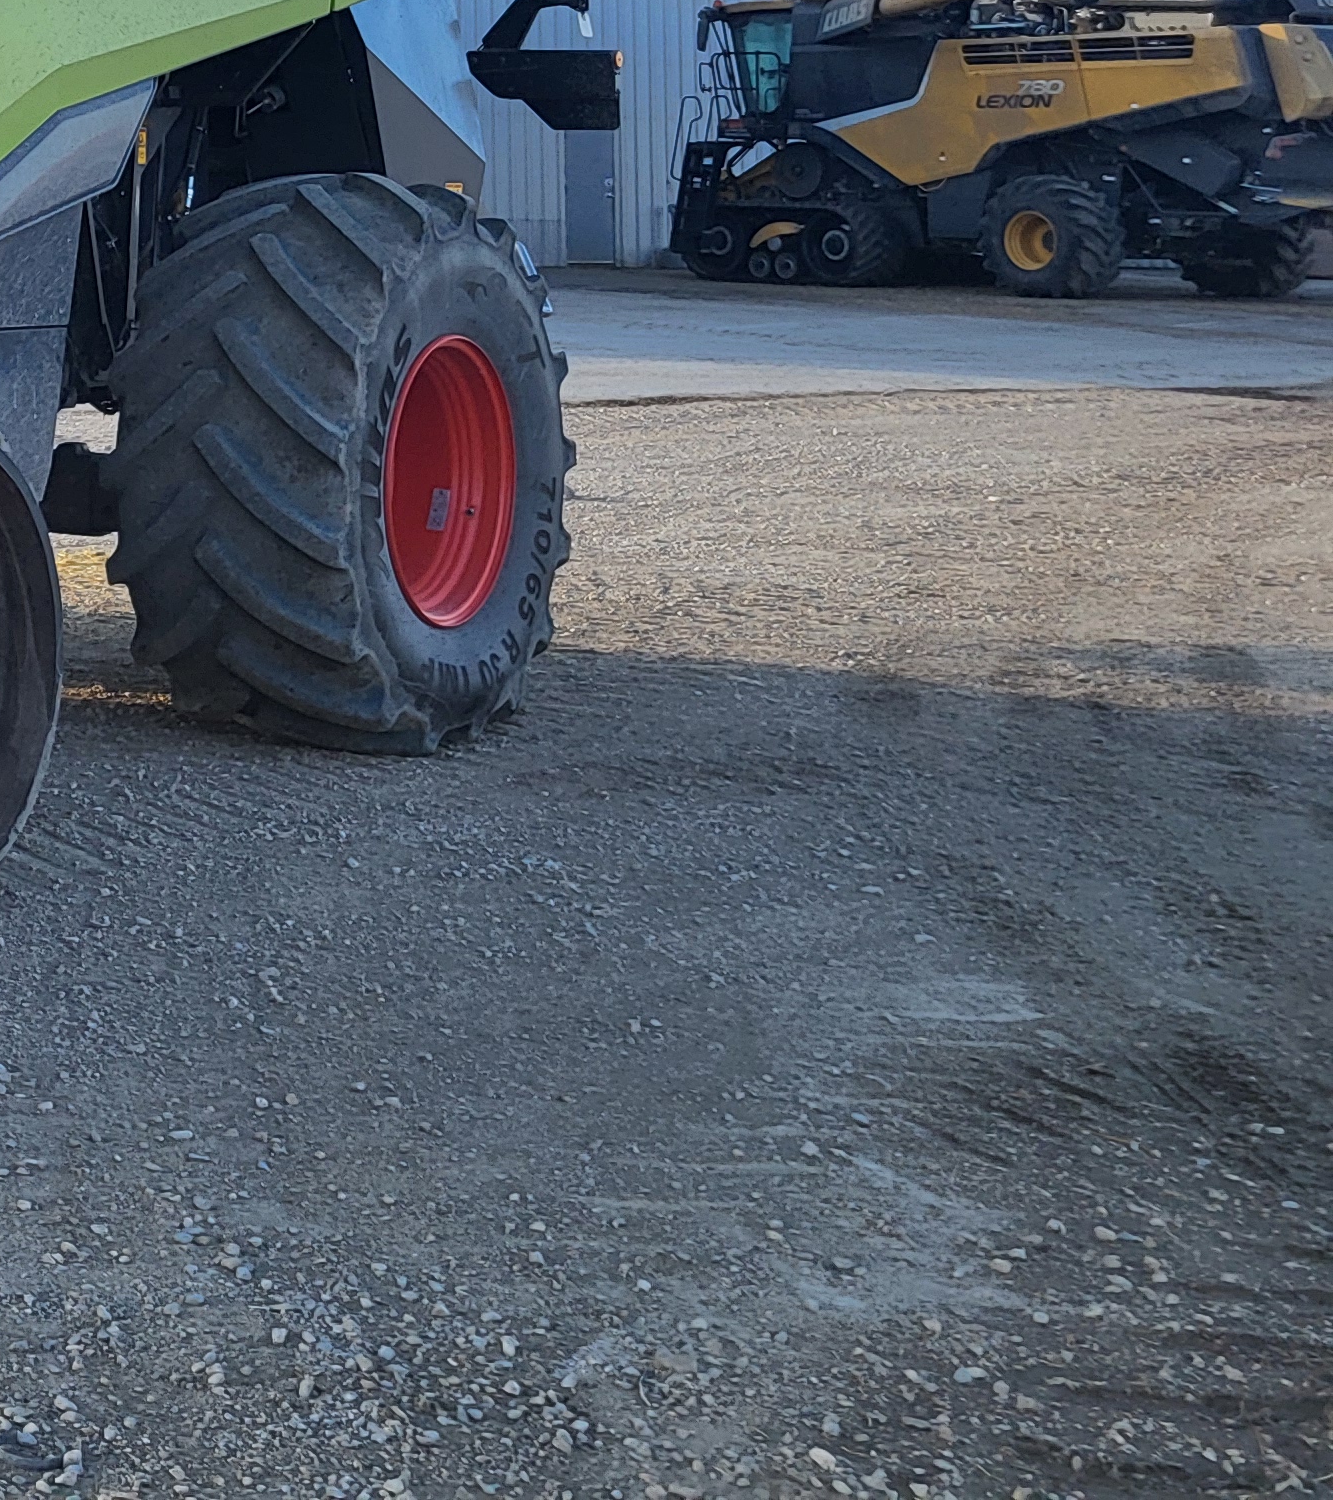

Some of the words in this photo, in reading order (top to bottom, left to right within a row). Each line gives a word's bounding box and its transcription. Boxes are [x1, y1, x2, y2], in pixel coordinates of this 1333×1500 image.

[822, 1, 866, 33] CLAAS
[976, 94, 1052, 109] LEXION
[518, 476, 557, 628] 710/65
